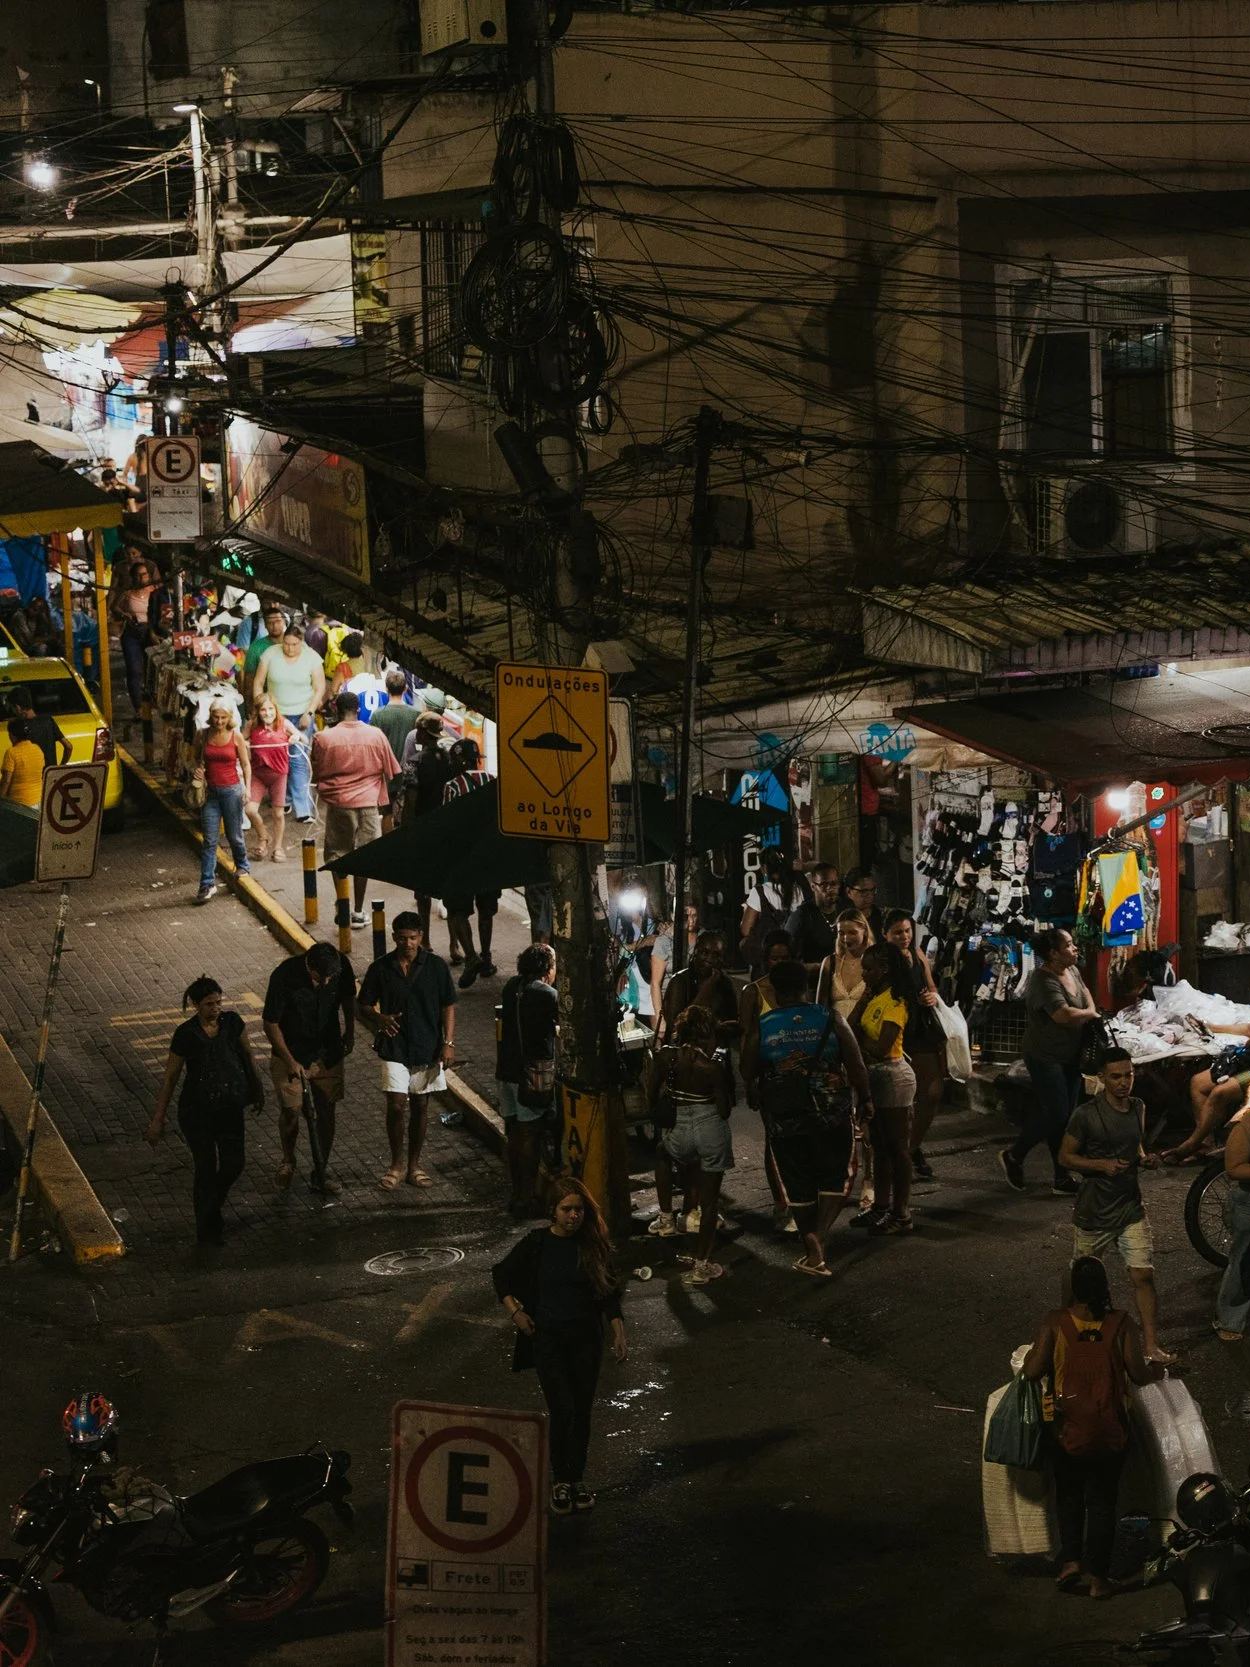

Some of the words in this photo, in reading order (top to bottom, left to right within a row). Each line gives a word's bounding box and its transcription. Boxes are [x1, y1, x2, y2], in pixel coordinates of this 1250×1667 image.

[166, 449, 181, 473] E
[503, 672, 600, 693] Ondulações
[861, 729, 916, 755] FANTA
[60, 782, 84, 821] E
[517, 802, 536, 814] ao
[543, 802, 592, 821] Longo
[530, 817, 548, 831] da
[555, 819, 581, 835] Via
[446, 1451, 490, 1526] E
[445, 1571, 491, 1585] Frete
[406, 1634, 427, 1646] Seg
[430, 1636, 435, 1644] a
[458, 1635, 477, 1645] das
[481, 1635, 489, 1645] 7
[465, 1655, 472, 1664] e
